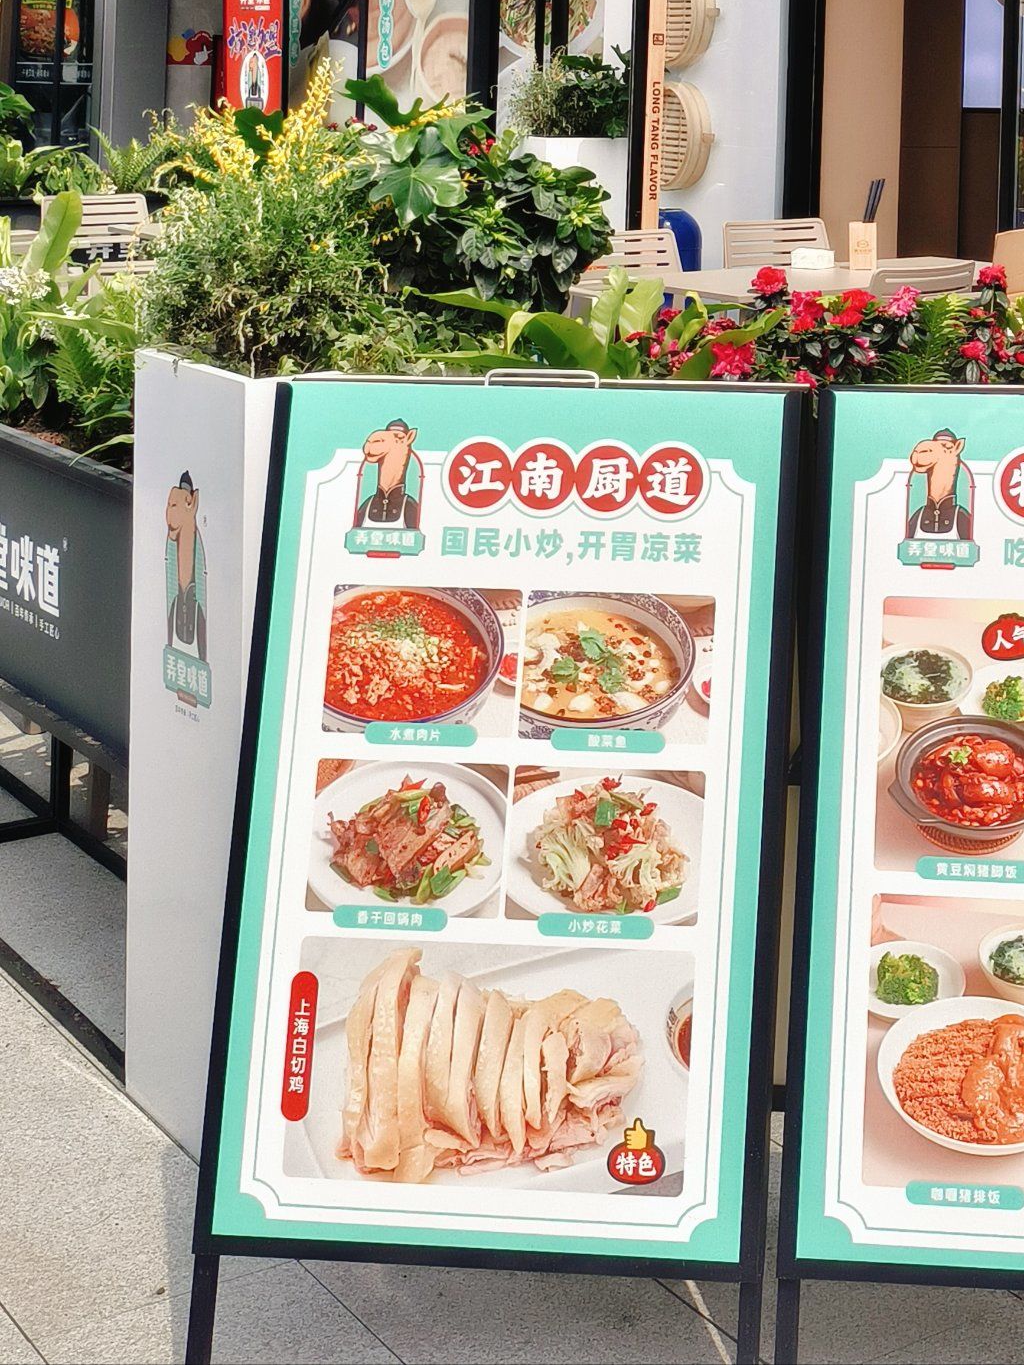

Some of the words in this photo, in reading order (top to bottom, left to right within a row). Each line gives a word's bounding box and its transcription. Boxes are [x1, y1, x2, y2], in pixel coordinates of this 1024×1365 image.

[652, 81, 661, 114] LONG
[650, 118, 660, 151] TANG
[648, 154, 659, 201] FLAVOR
[457, 451, 697, 504] 江南厨道
[390, 727, 441, 742] 水煮肉片
[587, 734, 628, 749] 酸菜鱼
[936, 862, 1018, 880] 黄豆焖猪脚饭
[357, 910, 423, 927] 香干回锅肉
[568, 918, 622, 934] 小炒花菜
[288, 998, 311, 1094] 上海白切鸡
[614, 1151, 658, 1177] 特色
[930, 1187, 1001, 1205] 咖喱猪排饭
